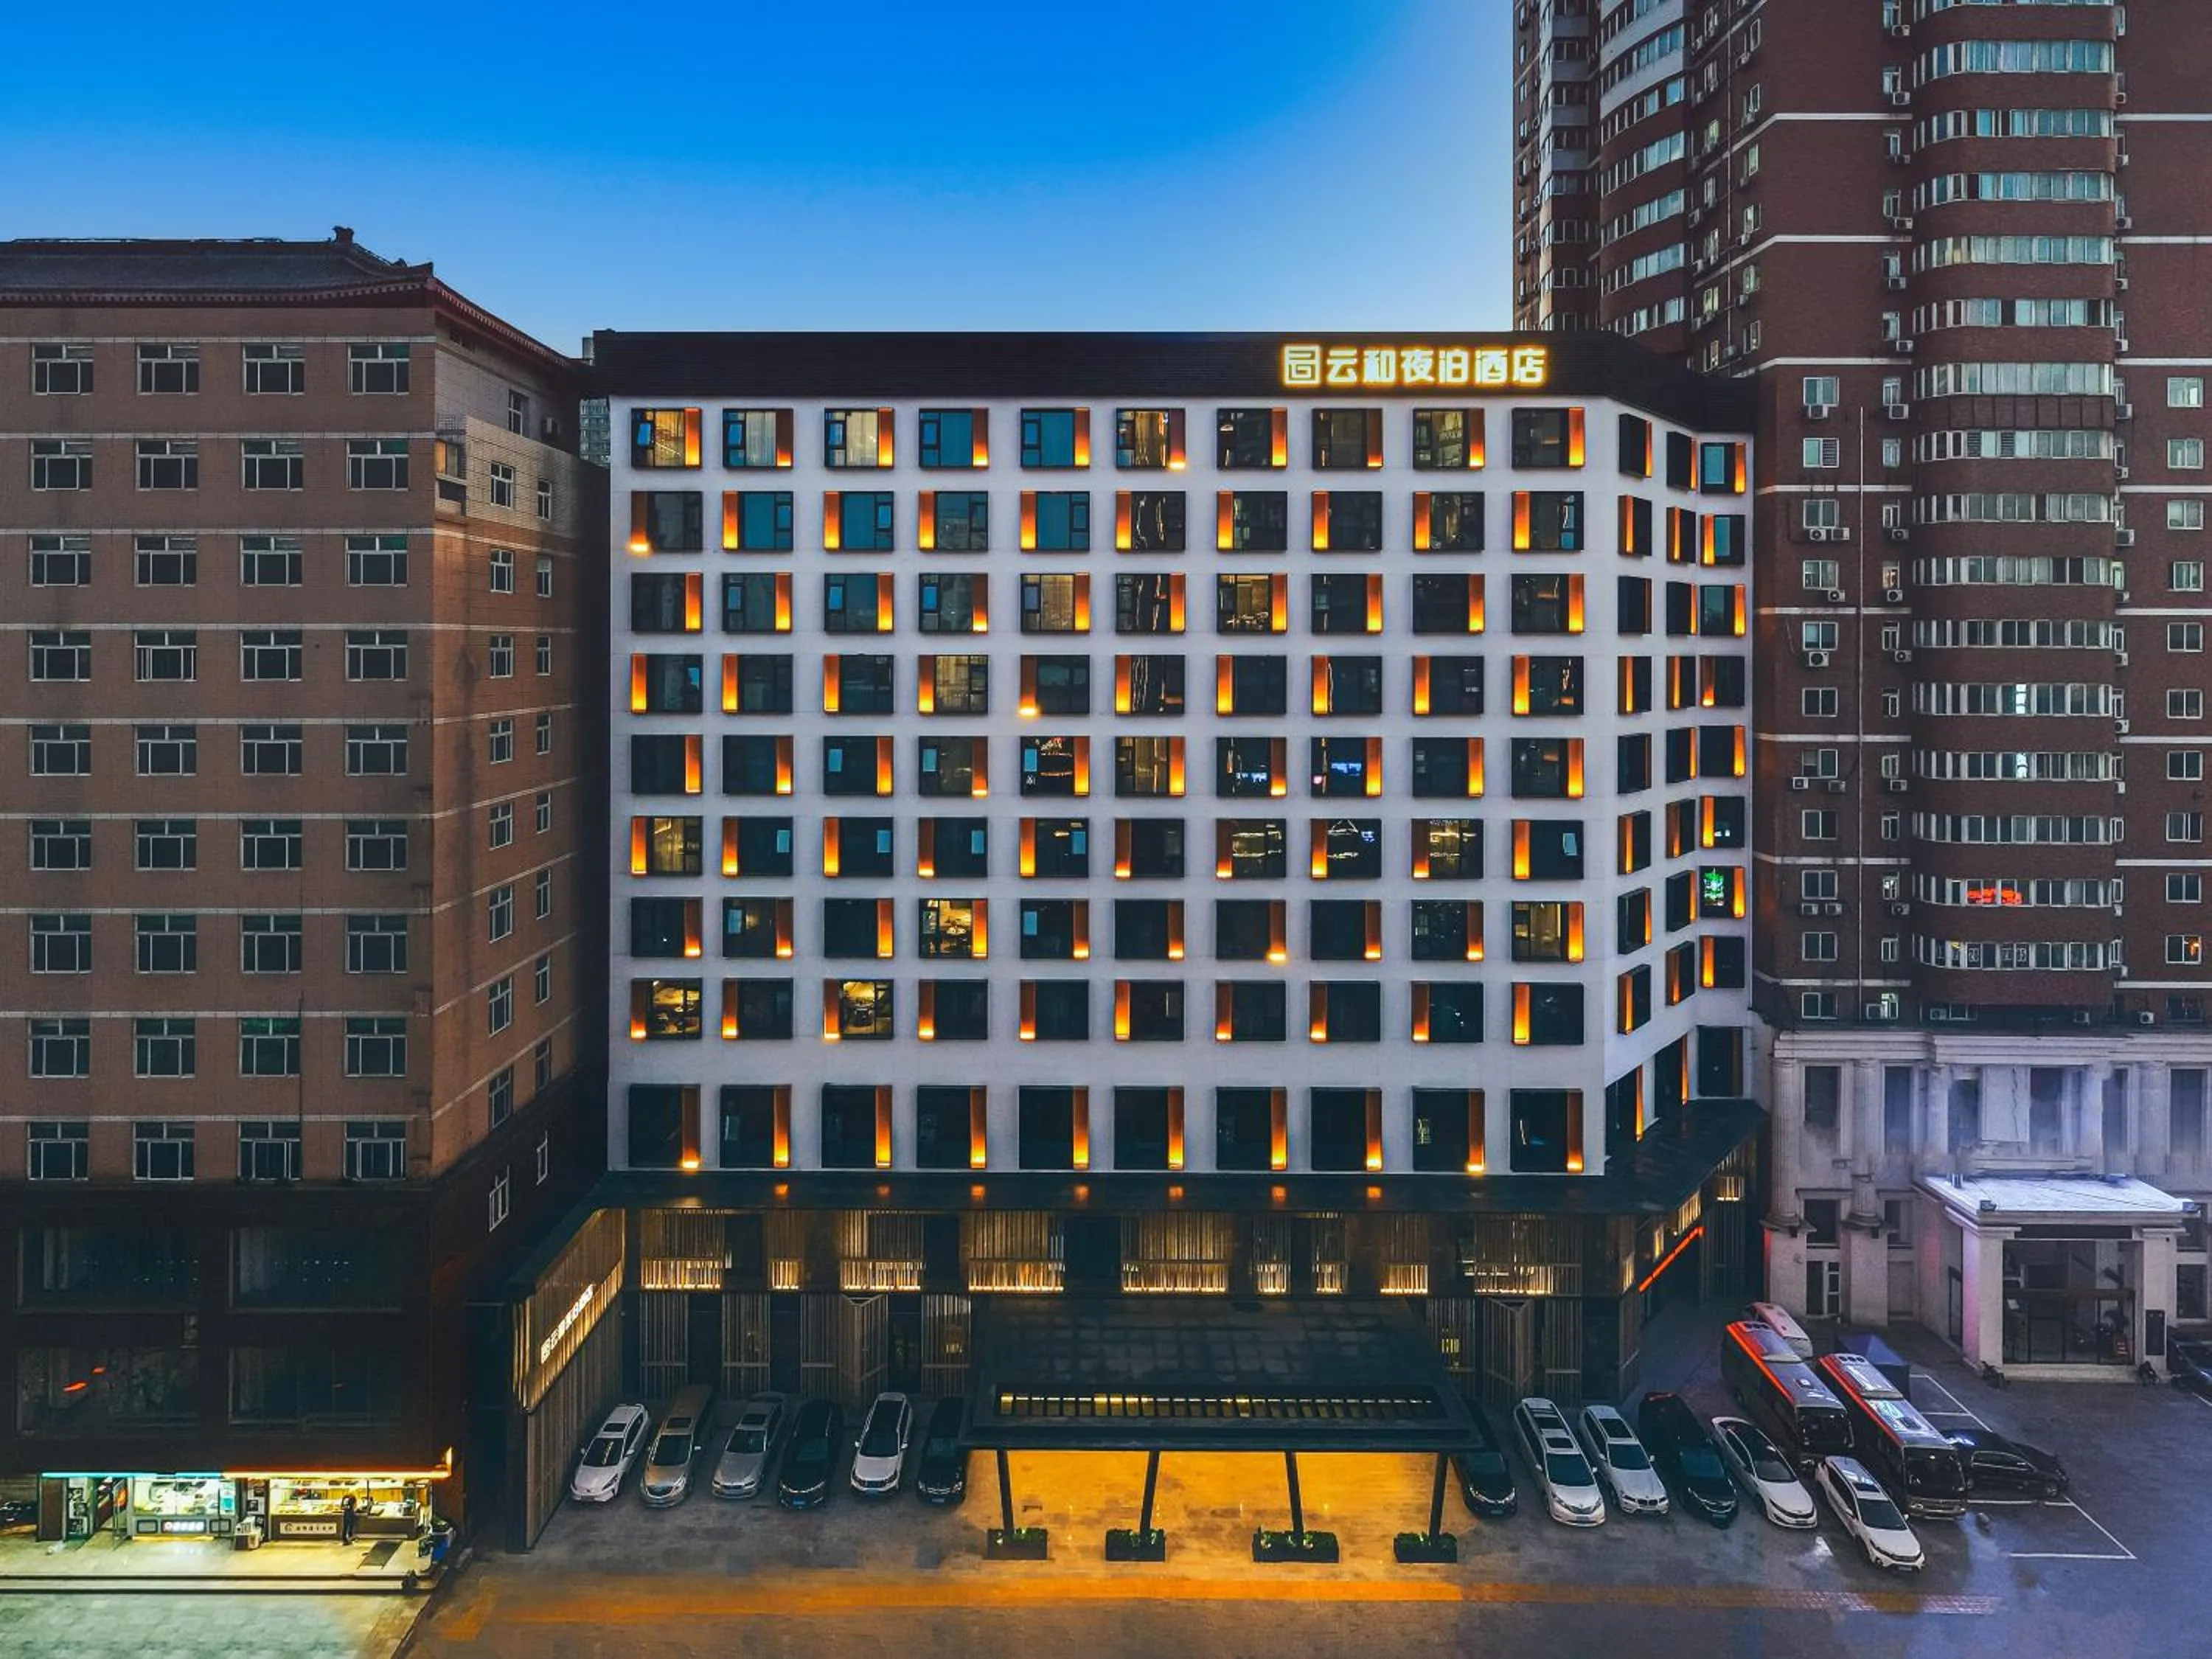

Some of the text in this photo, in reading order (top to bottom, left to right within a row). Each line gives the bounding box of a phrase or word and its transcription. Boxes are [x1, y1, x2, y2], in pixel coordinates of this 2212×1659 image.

[1326, 348, 1546, 383] 云和夜泊酒店
